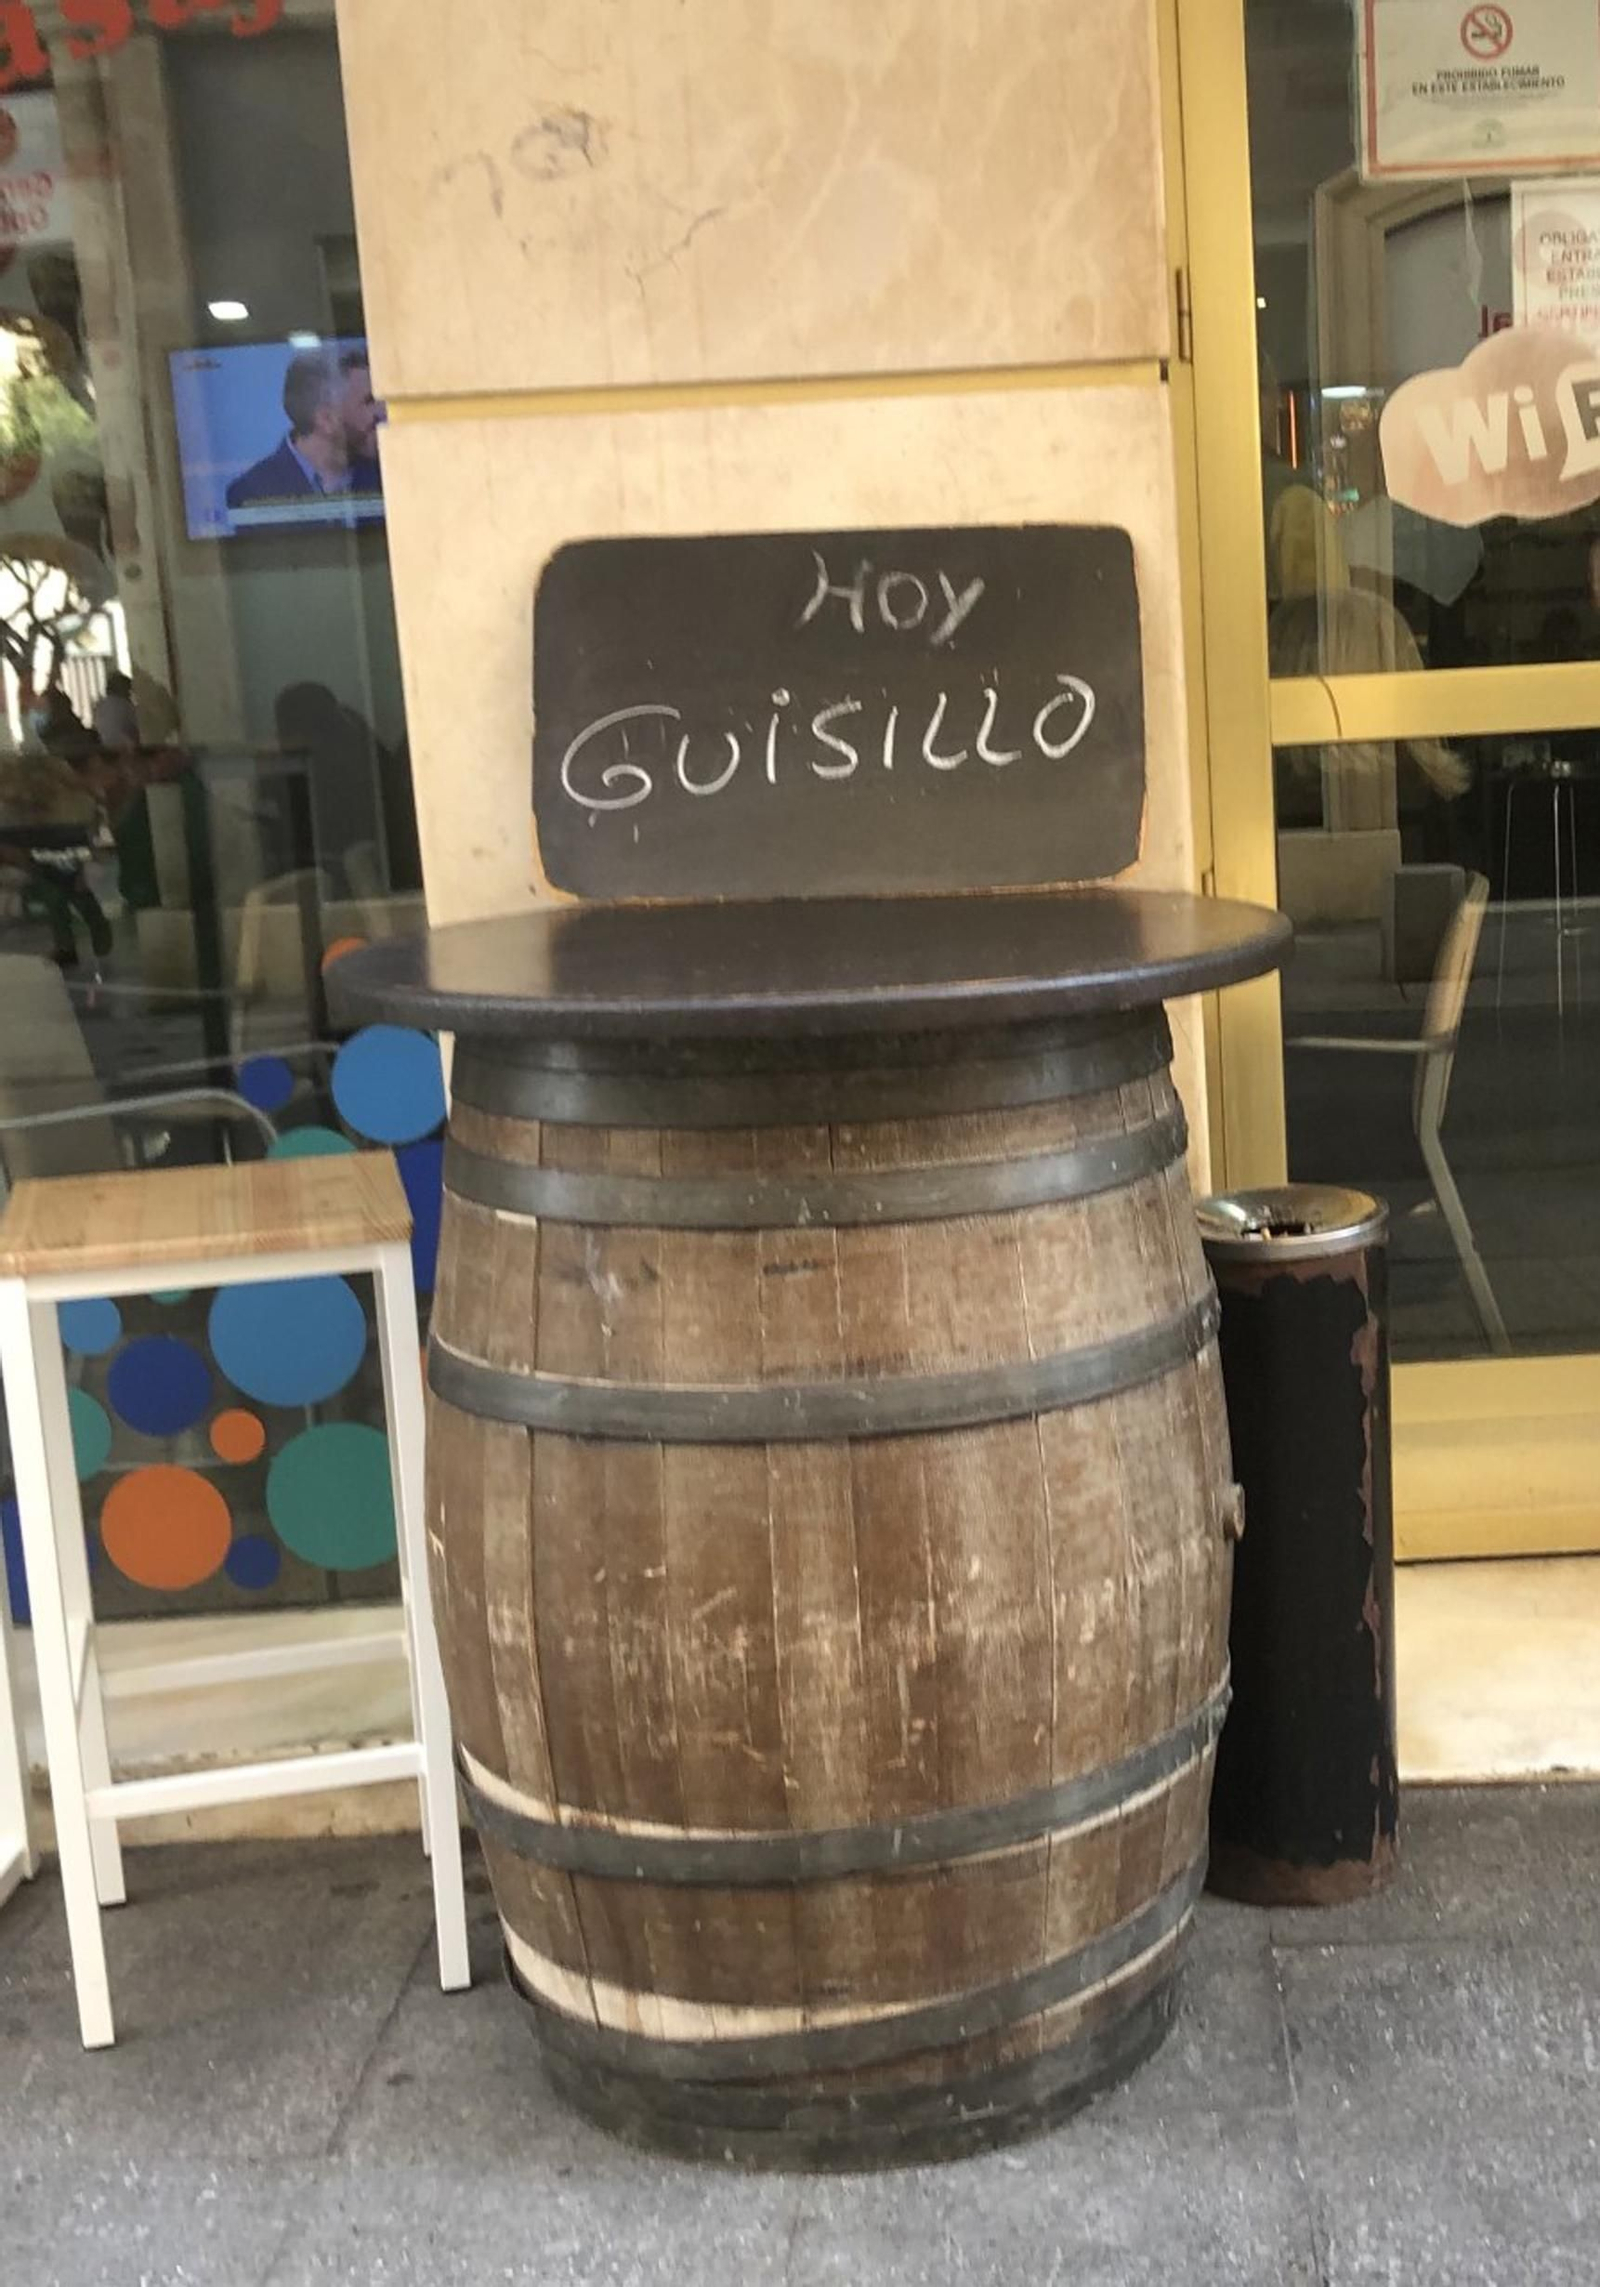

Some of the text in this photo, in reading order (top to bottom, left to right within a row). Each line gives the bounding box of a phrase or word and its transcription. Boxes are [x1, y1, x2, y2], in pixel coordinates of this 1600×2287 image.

[1501, 65, 1540, 77] FUMAR
[1412, 82, 1428, 95] EN
[1431, 80, 1457, 94] ESTE
[796, 549, 986, 646] HOY
